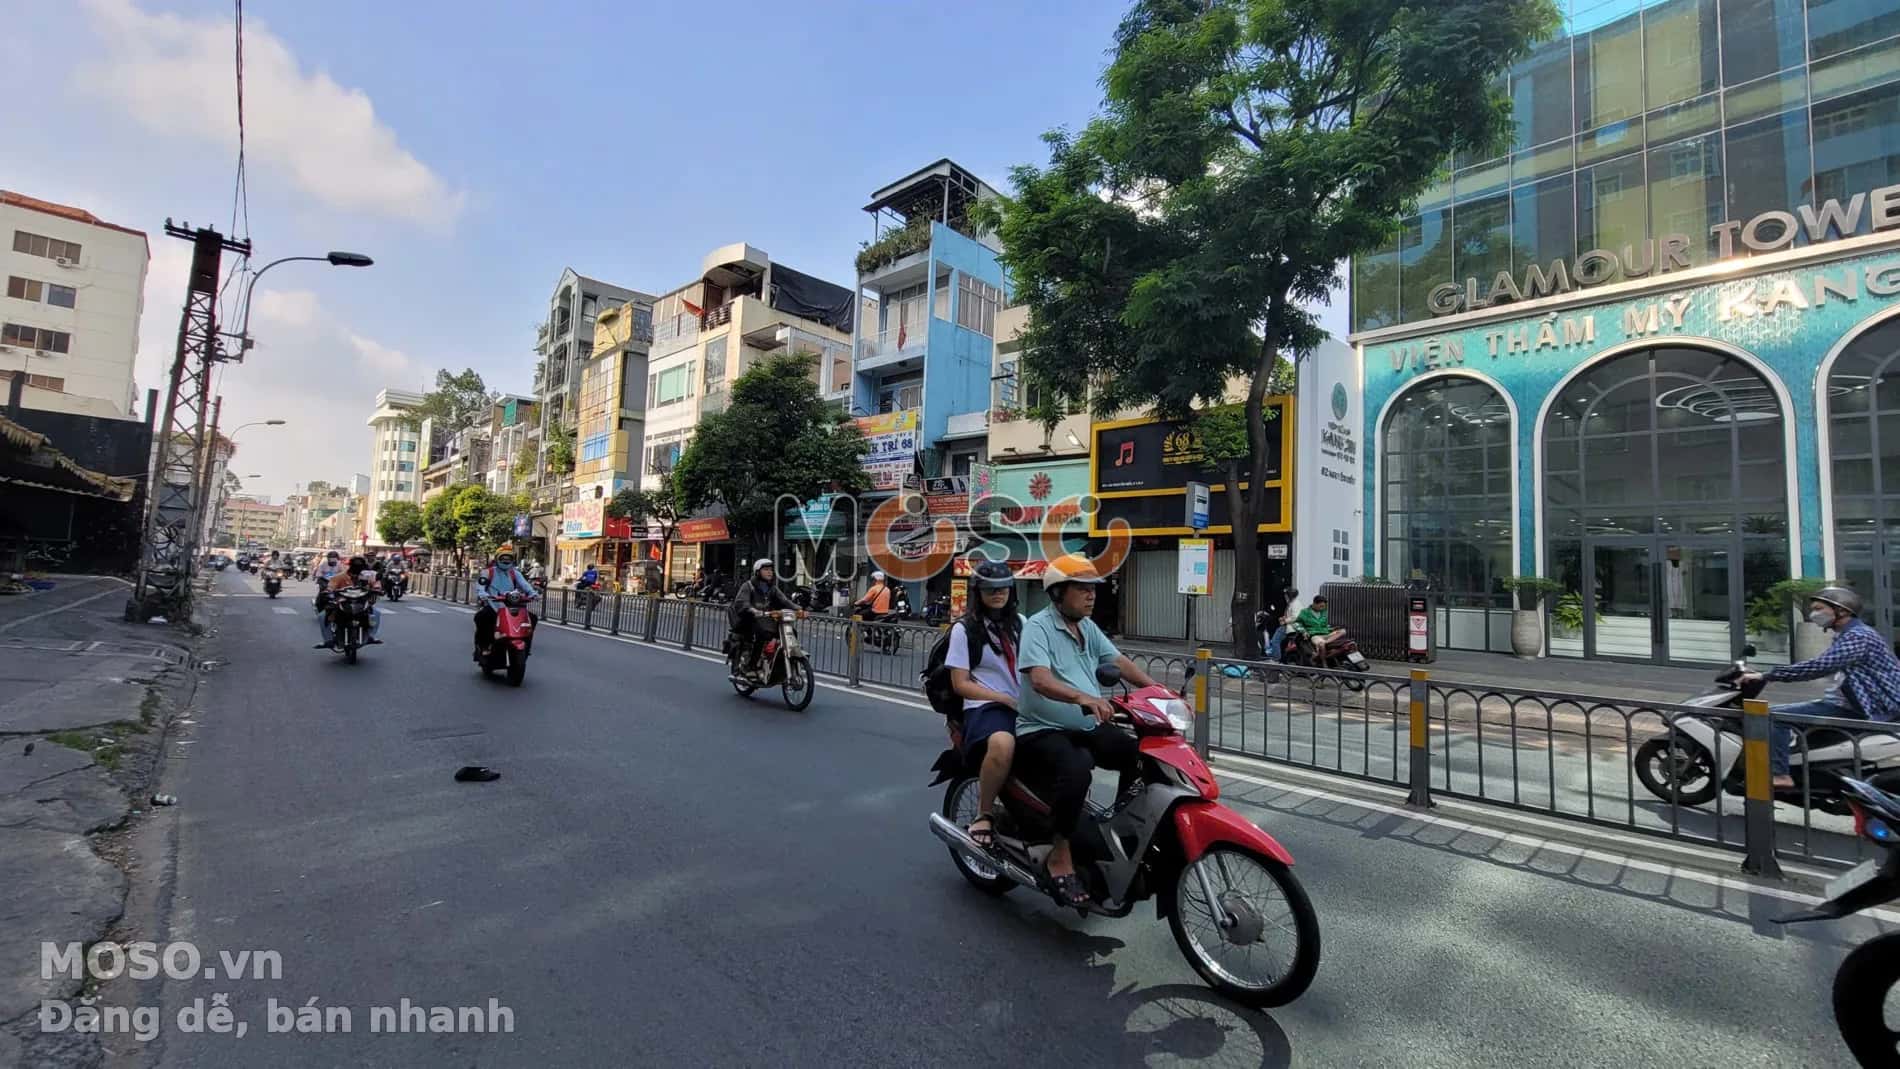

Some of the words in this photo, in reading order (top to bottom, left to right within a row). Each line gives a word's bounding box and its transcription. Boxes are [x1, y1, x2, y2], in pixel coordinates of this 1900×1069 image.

[1427, 233, 1691, 317] GLAMOUR
[1388, 336, 1465, 371] VIỆN
[1485, 311, 1595, 359] THẨM
[1623, 293, 1691, 338] MỸ
